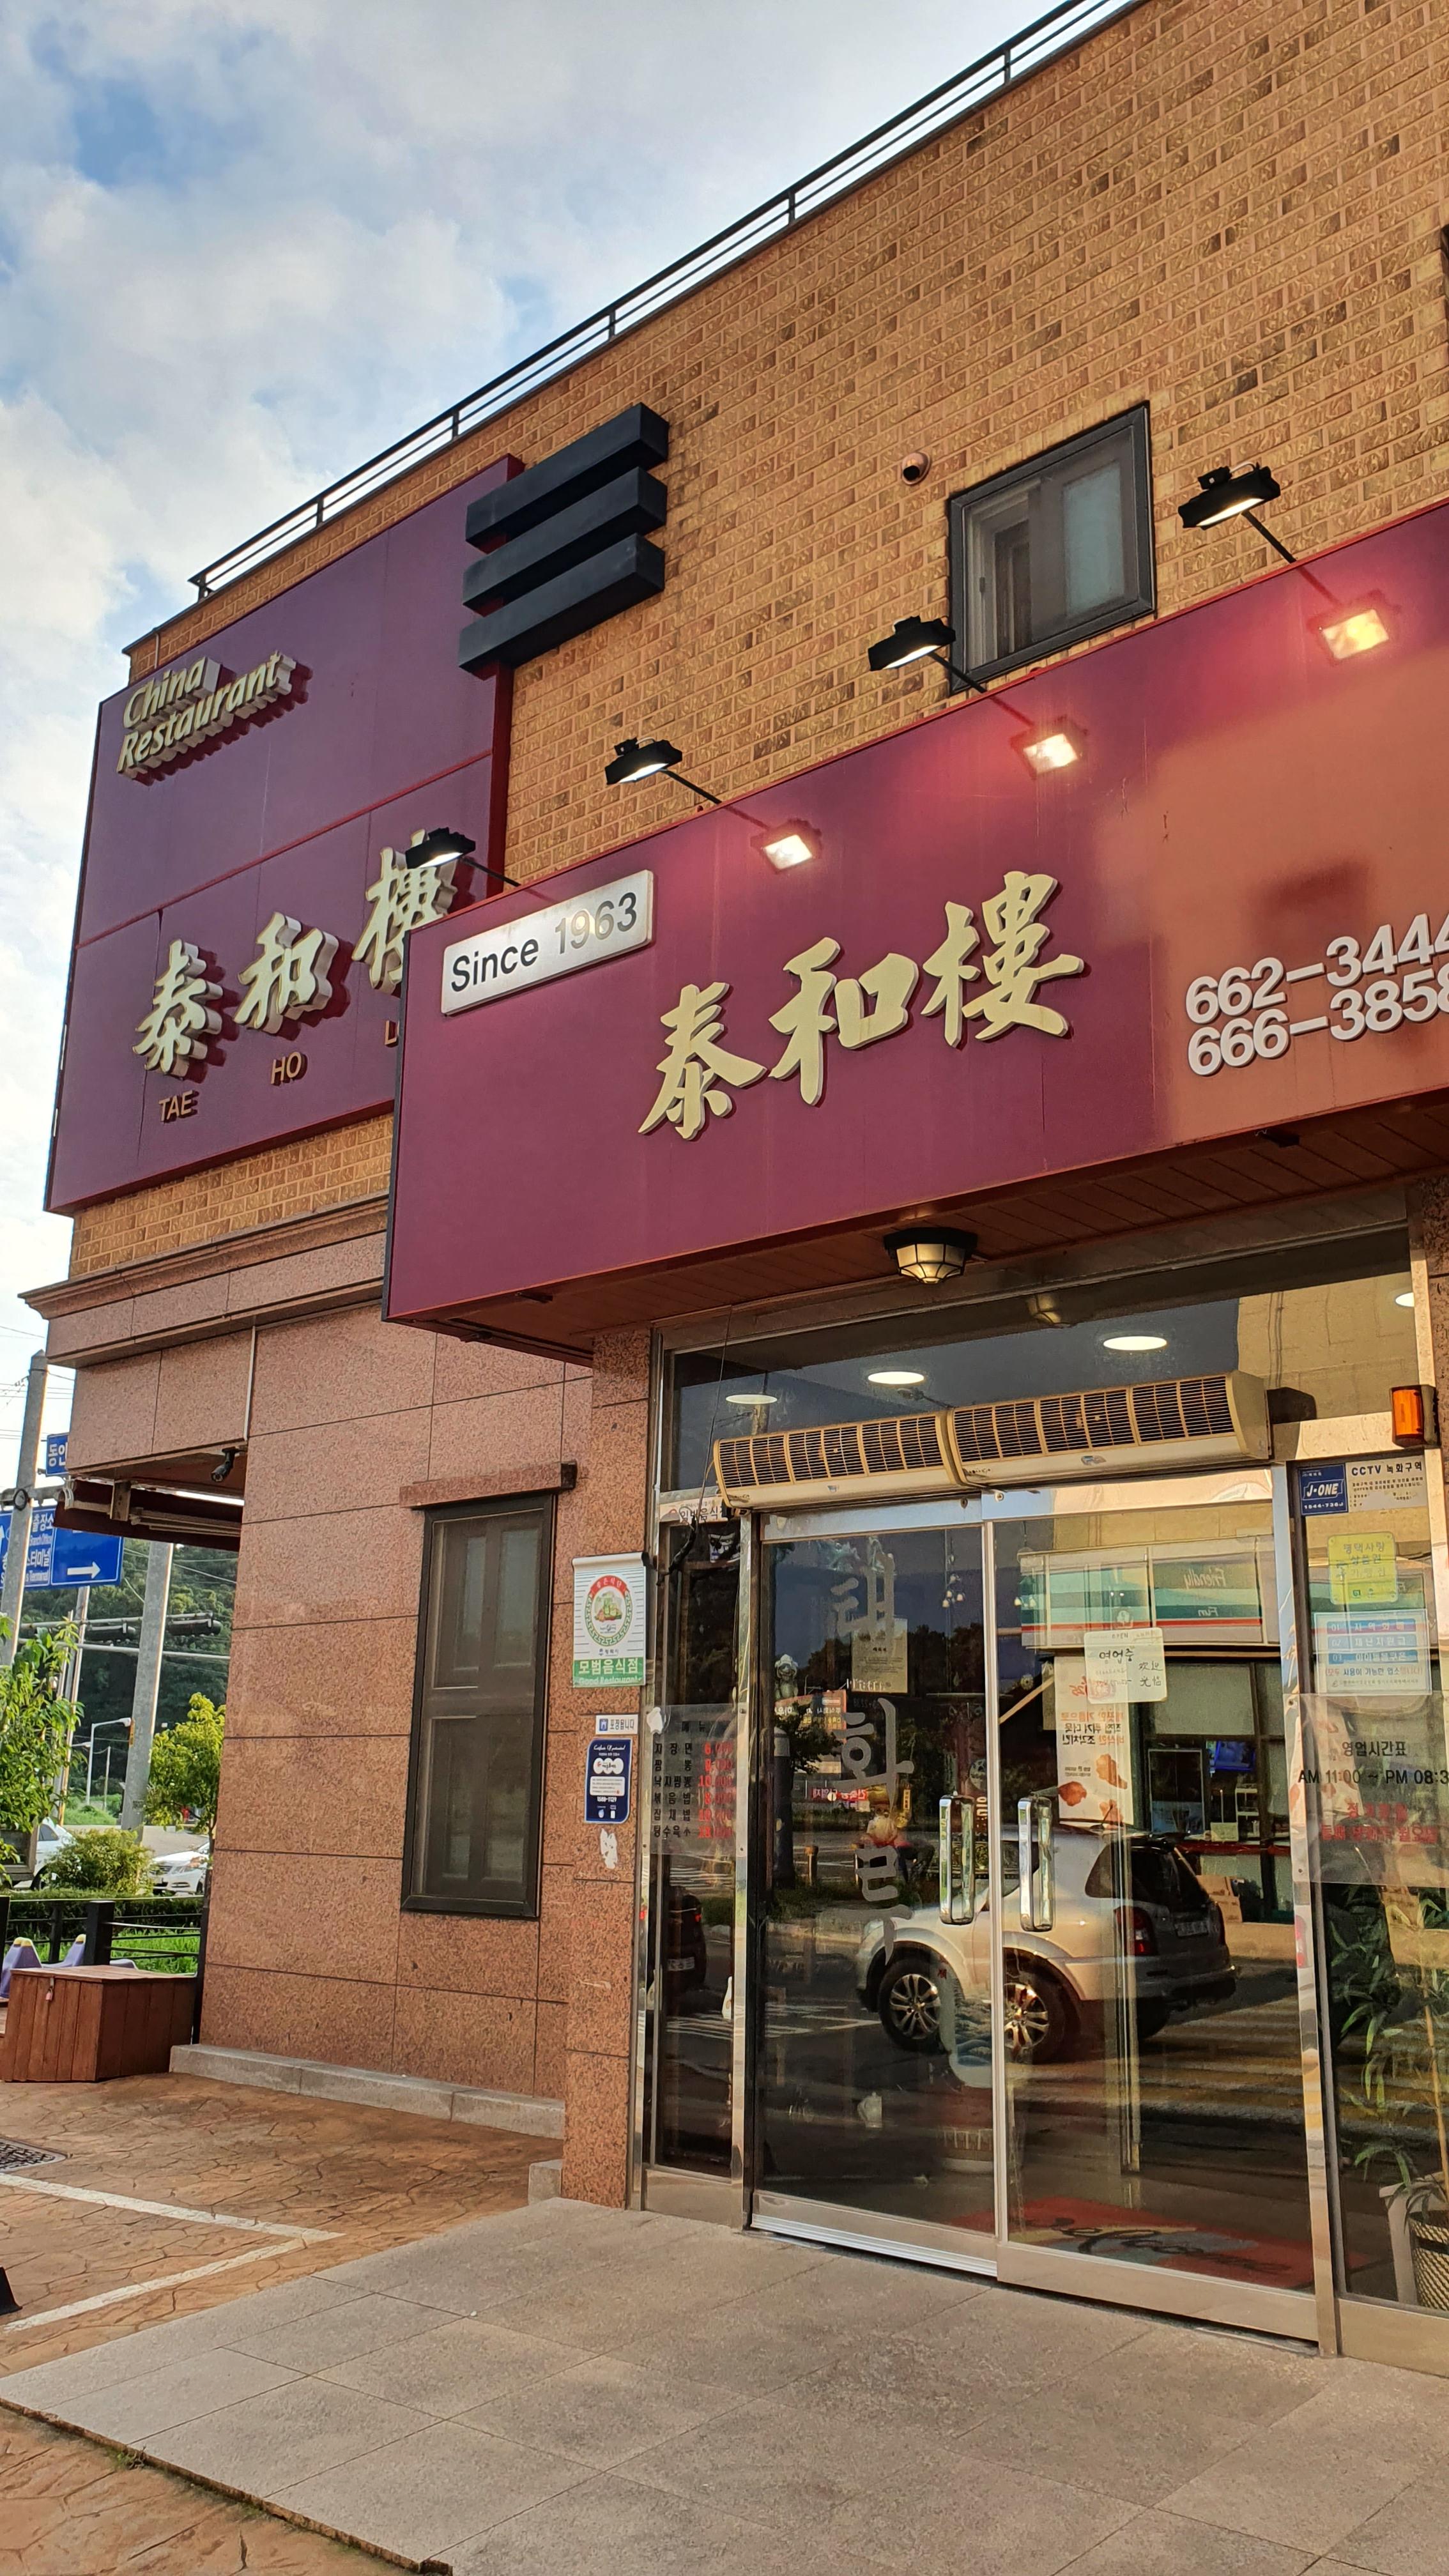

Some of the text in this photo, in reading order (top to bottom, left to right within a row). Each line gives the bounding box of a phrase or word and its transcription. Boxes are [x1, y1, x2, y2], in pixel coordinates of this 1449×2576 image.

[116, 650, 291, 774] Restaurant
[124, 656, 211, 729] China
[450, 891, 638, 992] Since 1963
[638, 871, 1084, 1140] 泰和樓
[158, 1090, 196, 1122] TAE
[271, 1053, 307, 1085] HO
[1351, 1462, 1422, 1476] CCTV 녹화구역
[578, 1658, 638, 1675] 모범음식점
[1298, 1770, 1320, 1784] AM
[1325, 1769, 1360, 1784] 11:00
[1385, 1770, 1408, 1784] PM
[1342, 1741, 1407, 1756] 영업시간표
